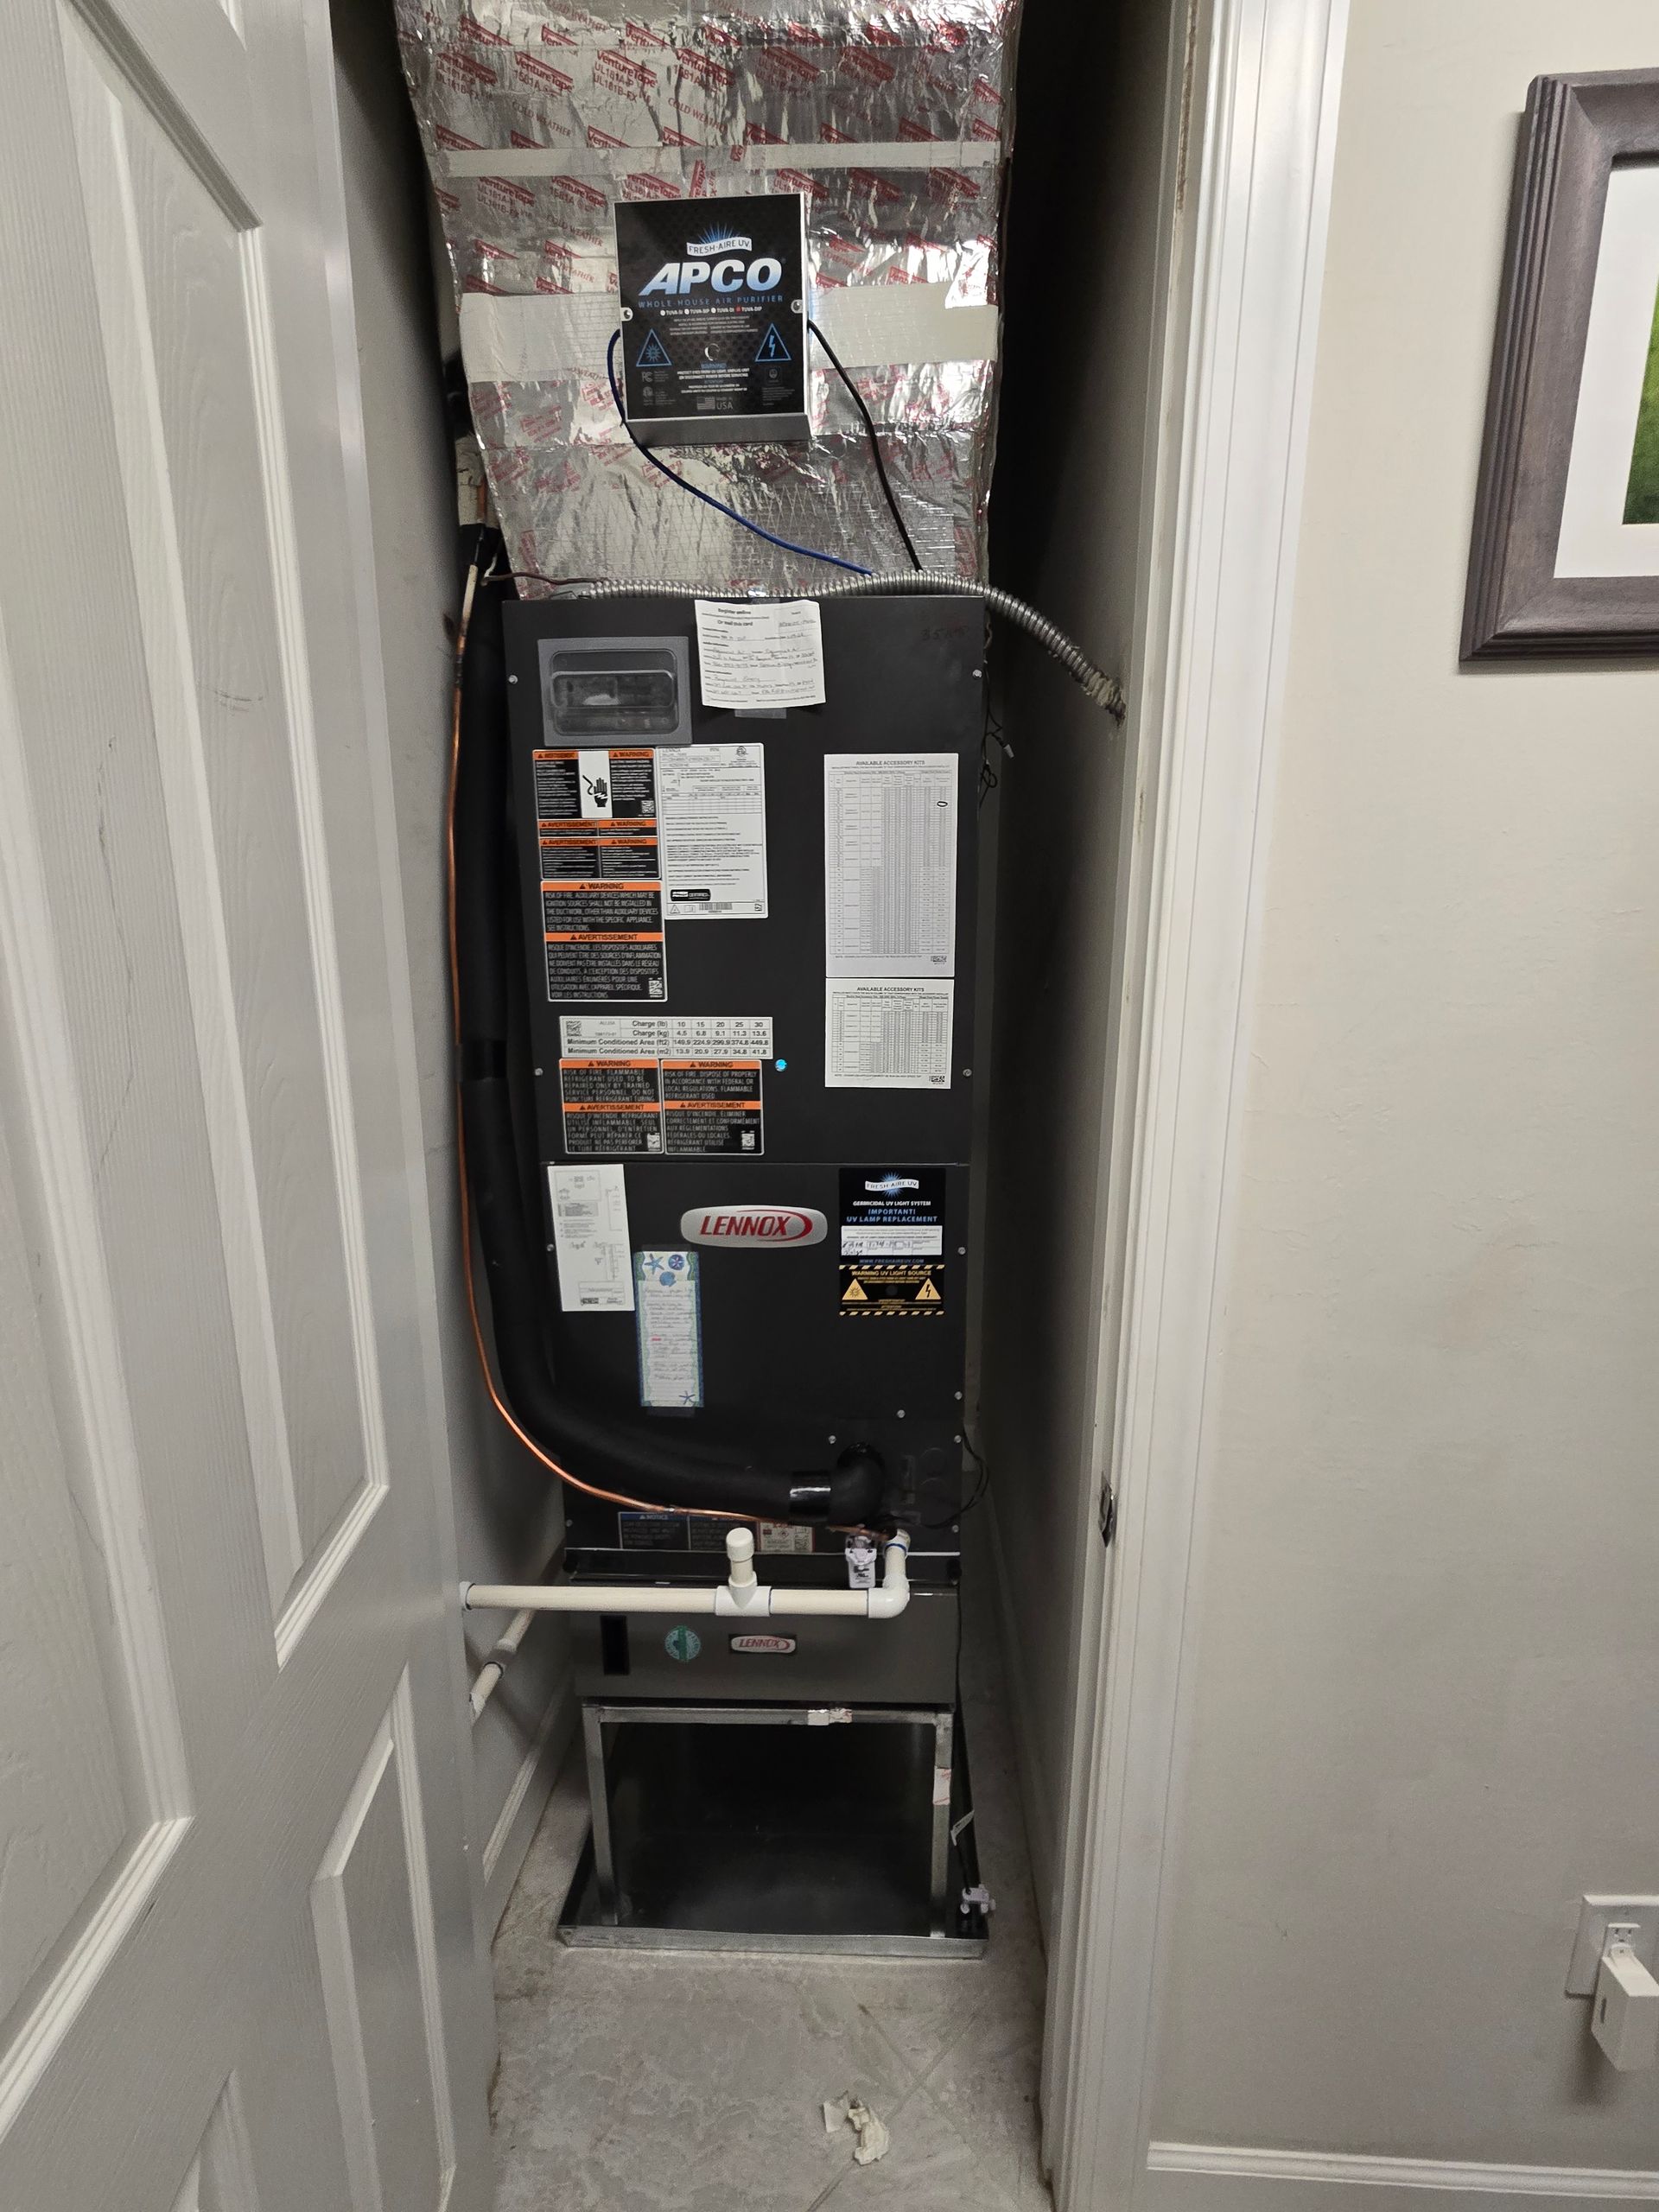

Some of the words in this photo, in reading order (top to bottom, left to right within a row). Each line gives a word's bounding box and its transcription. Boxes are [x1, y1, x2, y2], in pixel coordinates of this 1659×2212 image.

[738, 239, 750, 248] UV
[639, 257, 782, 296] APCO
[716, 402, 734, 410] USA
[699, 1215, 791, 1236] LENNOX
[739, 1638, 779, 1648] LENNOX
